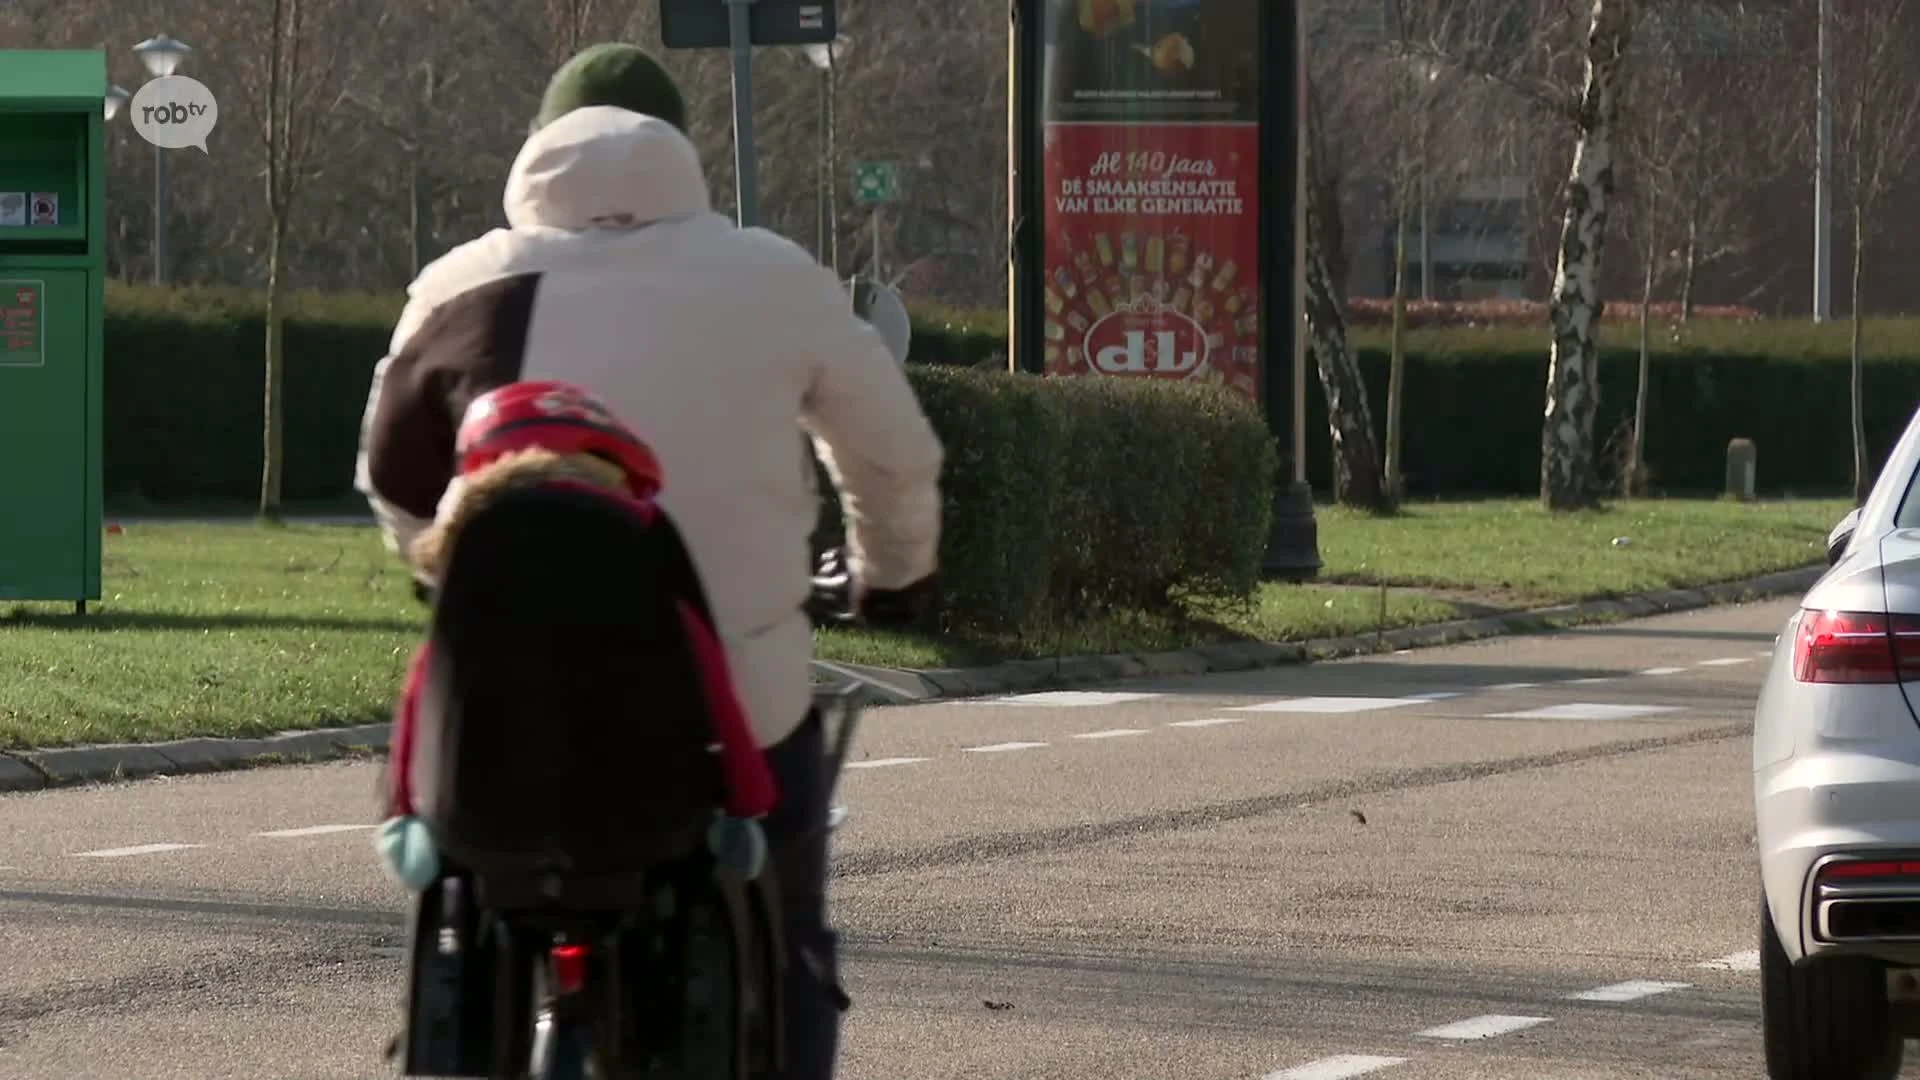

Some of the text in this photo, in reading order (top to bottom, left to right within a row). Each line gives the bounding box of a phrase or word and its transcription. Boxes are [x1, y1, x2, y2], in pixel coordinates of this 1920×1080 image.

[1090, 151, 1217, 179] Al 140 jaar
[1086, 180, 1237, 197] SMAAKSENSATIE
[1055, 197, 1243, 215] VAN ELKE GENERATIE
